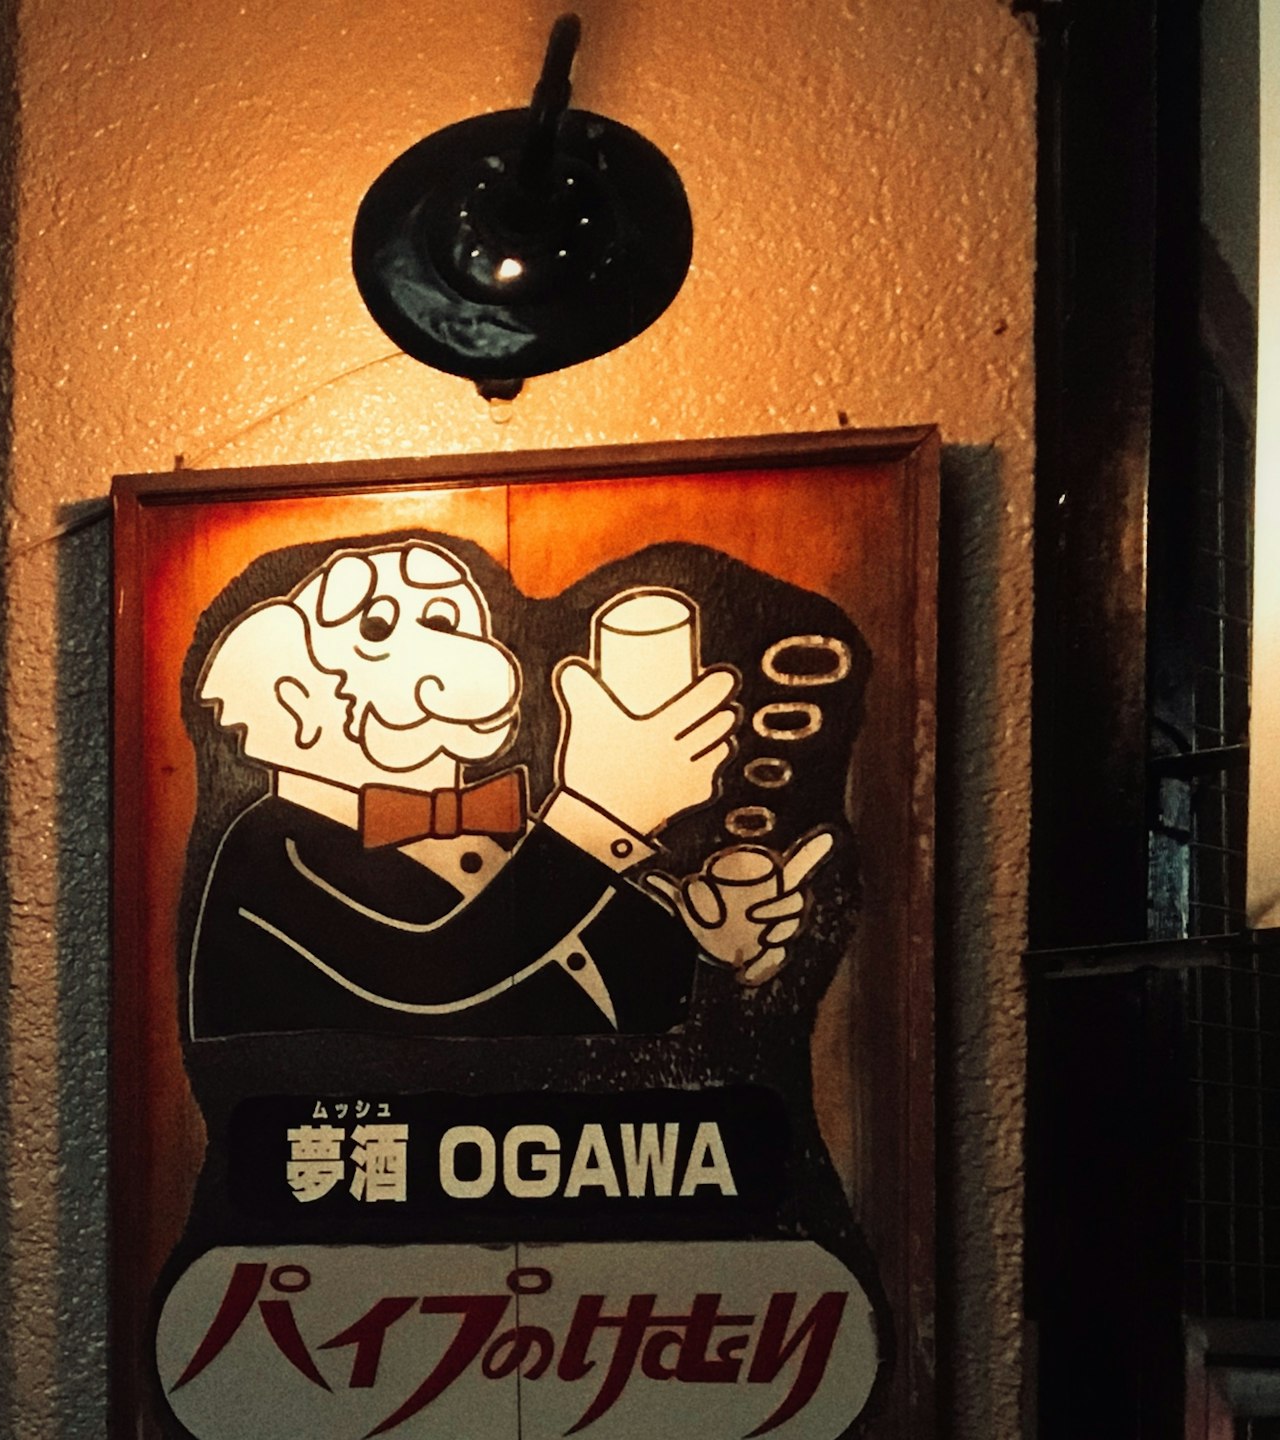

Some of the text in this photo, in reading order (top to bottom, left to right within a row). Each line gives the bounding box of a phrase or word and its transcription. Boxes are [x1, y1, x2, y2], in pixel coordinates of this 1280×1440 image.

[311, 1100, 393, 1119] ムッシュ
[285, 1121, 738, 1204] 夢酒 OGAWA
[169, 1262, 850, 1440] パイプのけむり
